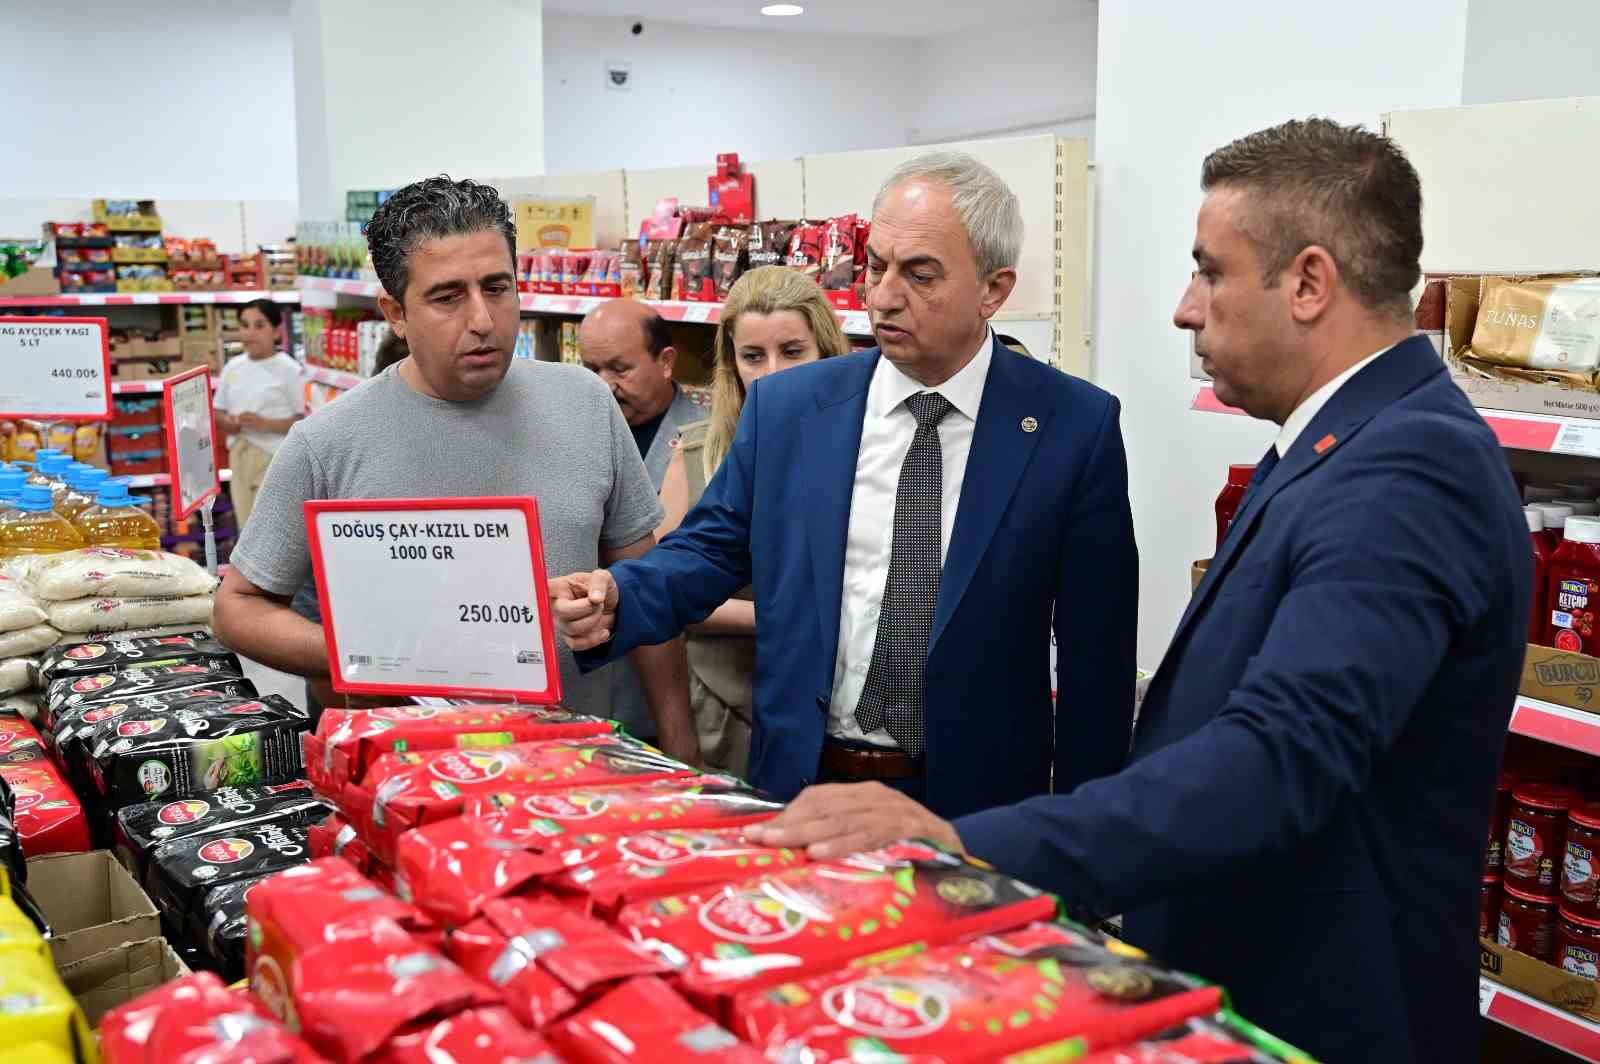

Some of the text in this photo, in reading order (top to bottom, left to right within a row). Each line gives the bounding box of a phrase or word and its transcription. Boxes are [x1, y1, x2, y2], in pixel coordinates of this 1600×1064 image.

[332, 519, 509, 541] DOĞUŞ ÇAY-KIZIL DEM
[389, 545, 455, 560] 1000 GR
[458, 604, 534, 624] 250.00₺
